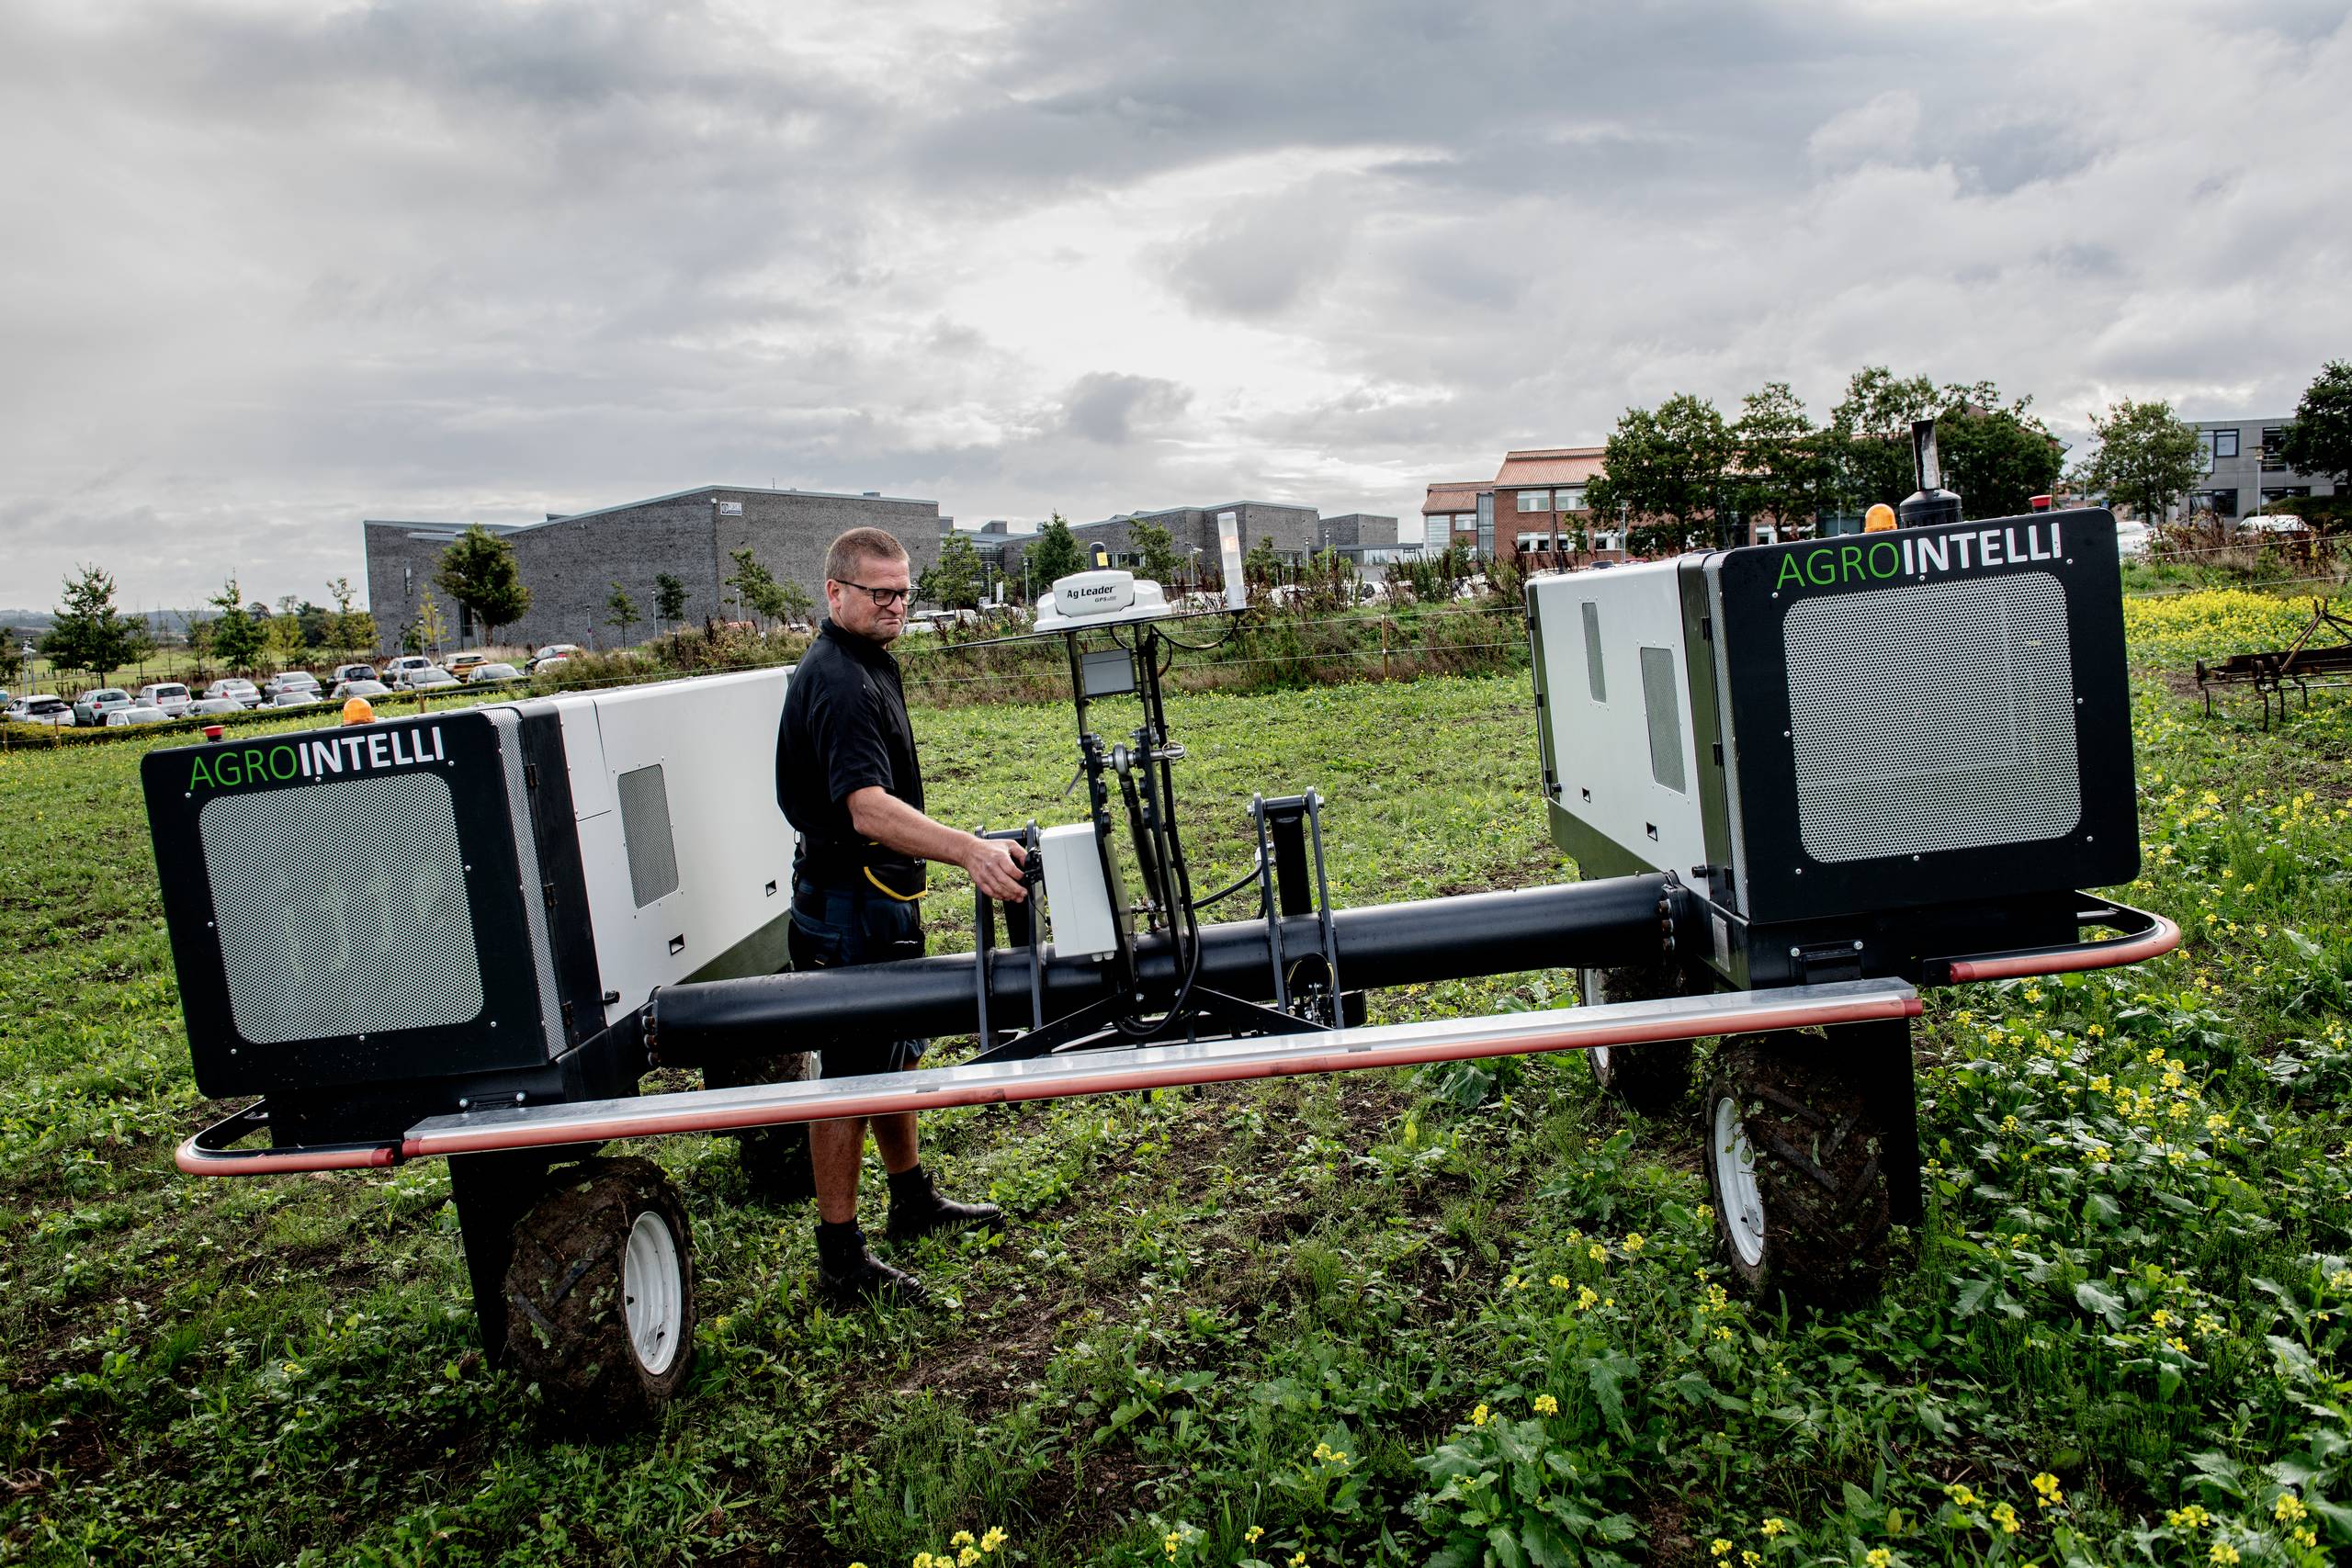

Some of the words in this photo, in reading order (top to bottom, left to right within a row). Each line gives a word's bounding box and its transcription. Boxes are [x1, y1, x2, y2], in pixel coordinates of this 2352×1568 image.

[1777, 523, 2062, 590] AGROINTELLI
[1067, 590, 1079, 599] Ag
[1080, 586, 1114, 596] Leader
[189, 727, 445, 790] AGROINTELLI
